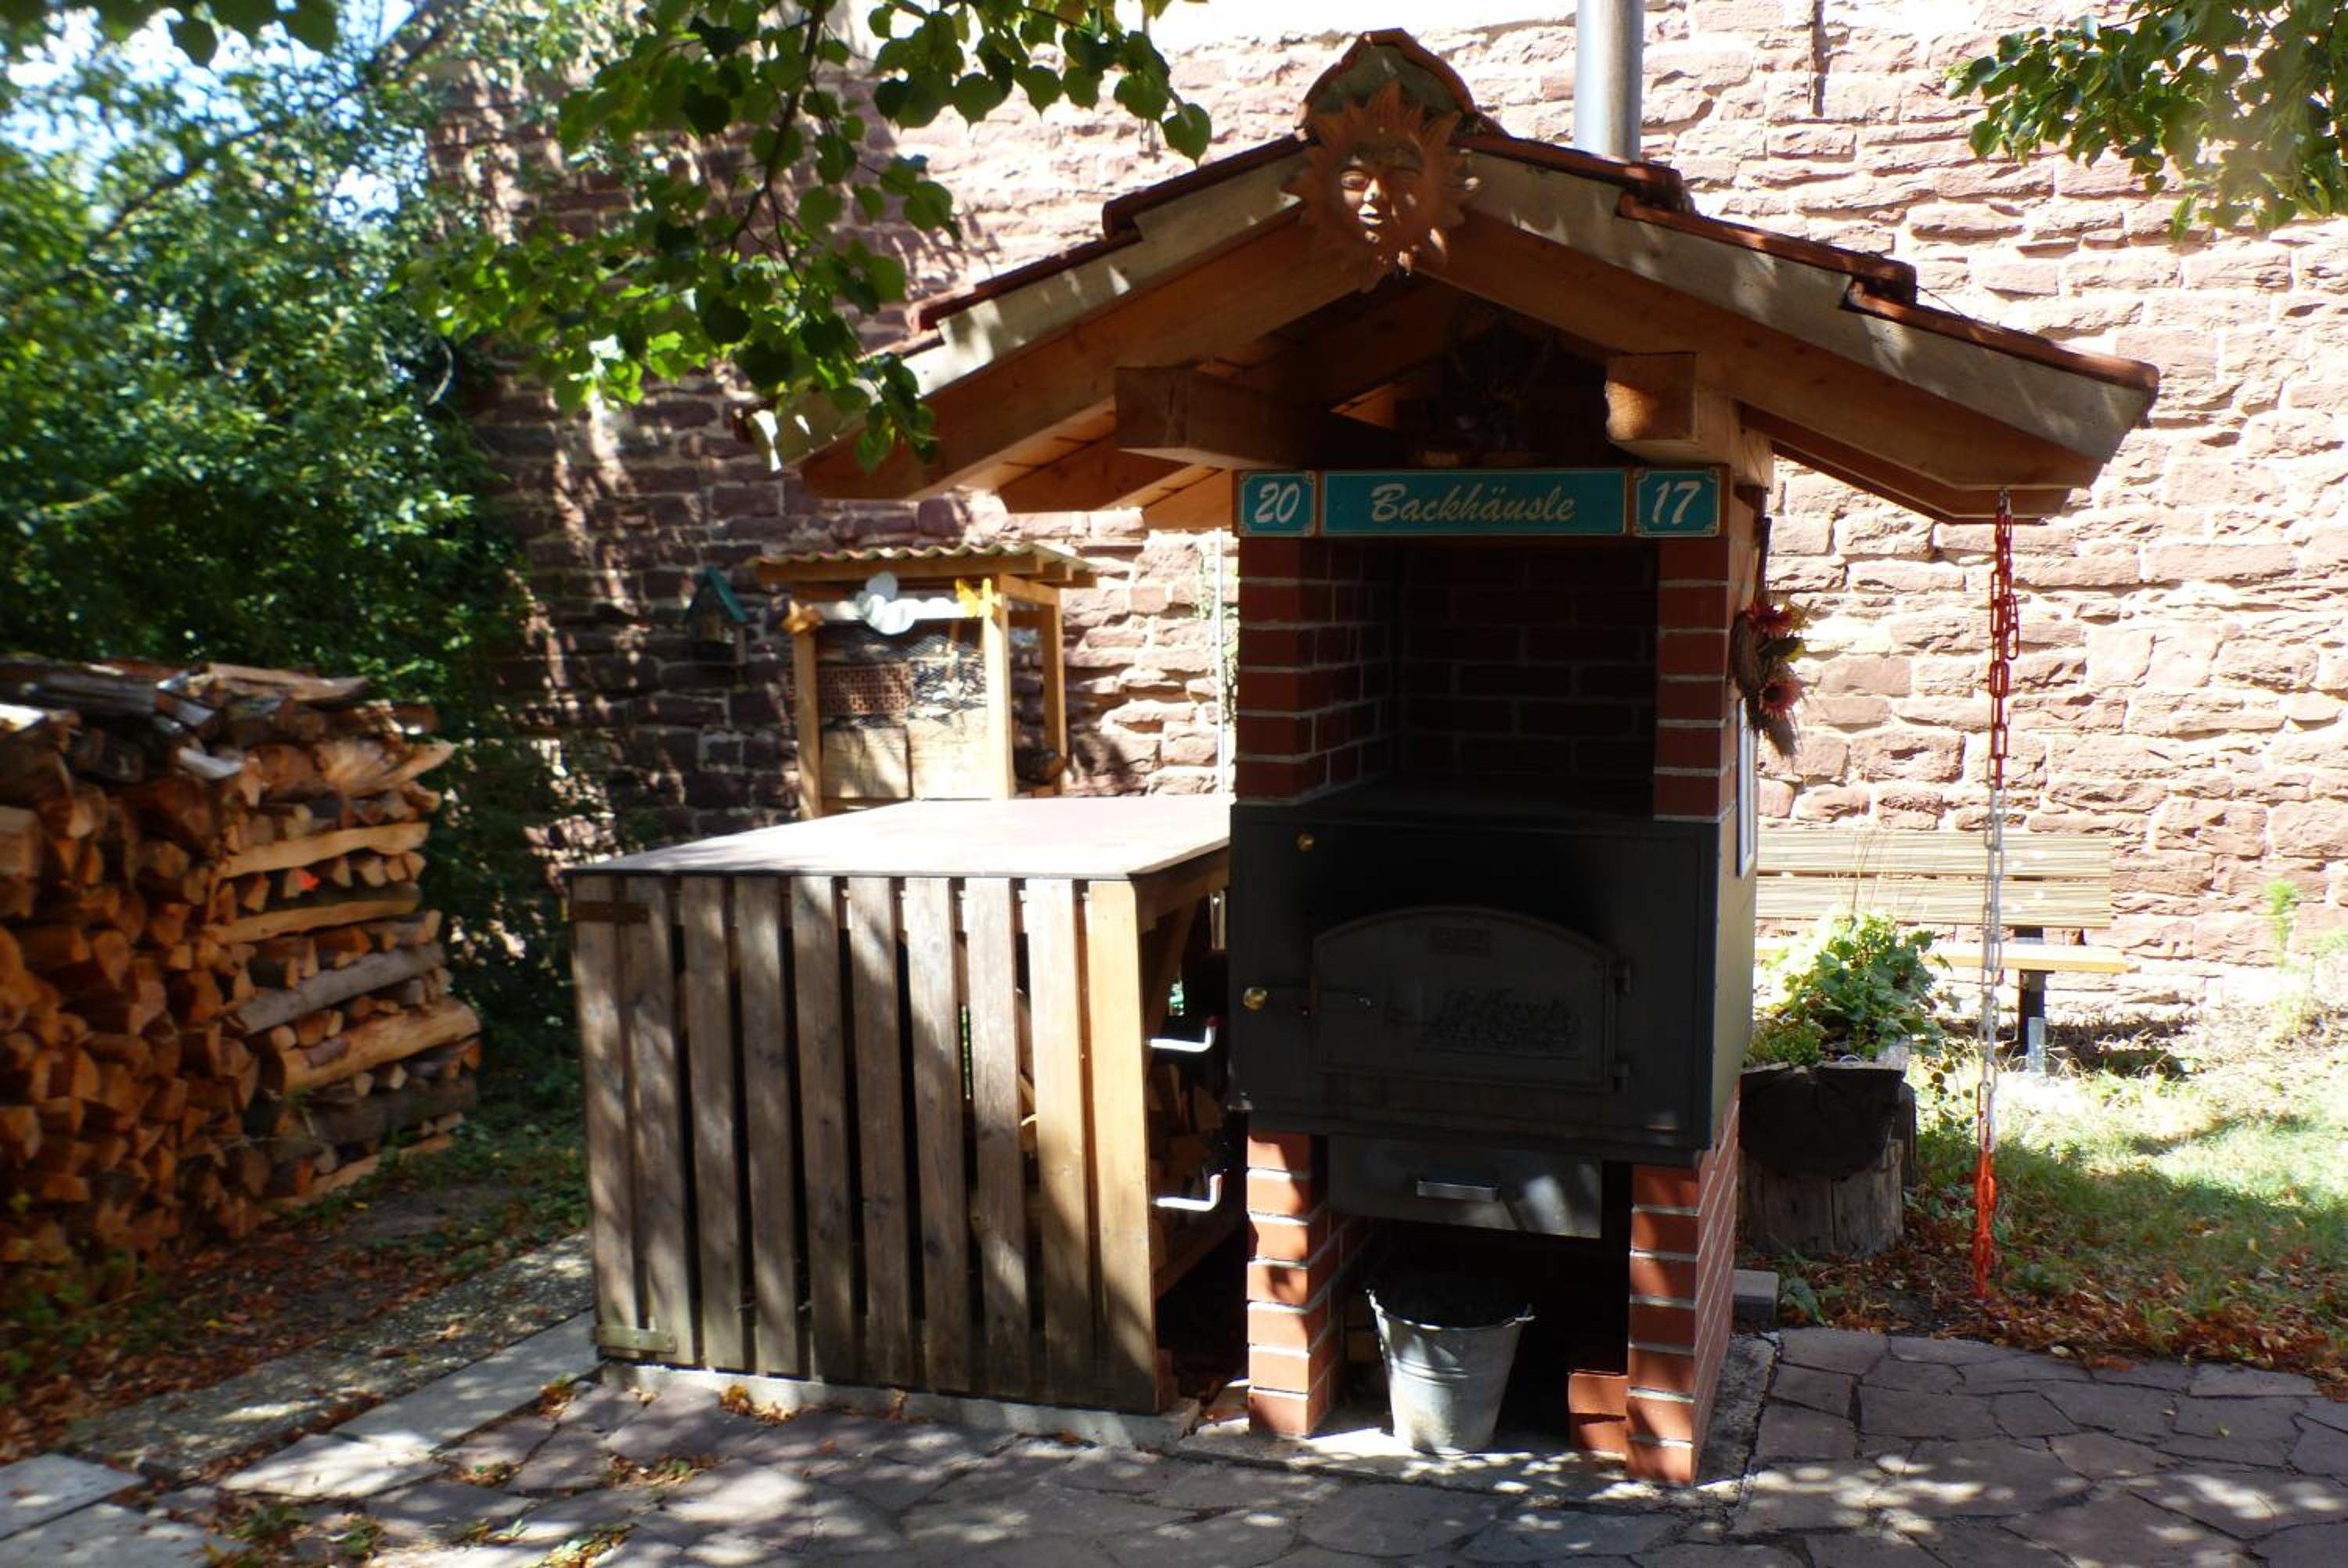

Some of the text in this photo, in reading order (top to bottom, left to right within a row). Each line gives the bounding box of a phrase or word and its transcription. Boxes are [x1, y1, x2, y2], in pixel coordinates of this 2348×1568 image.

[1255, 480, 1702, 525] 20 Backhäusle 17
